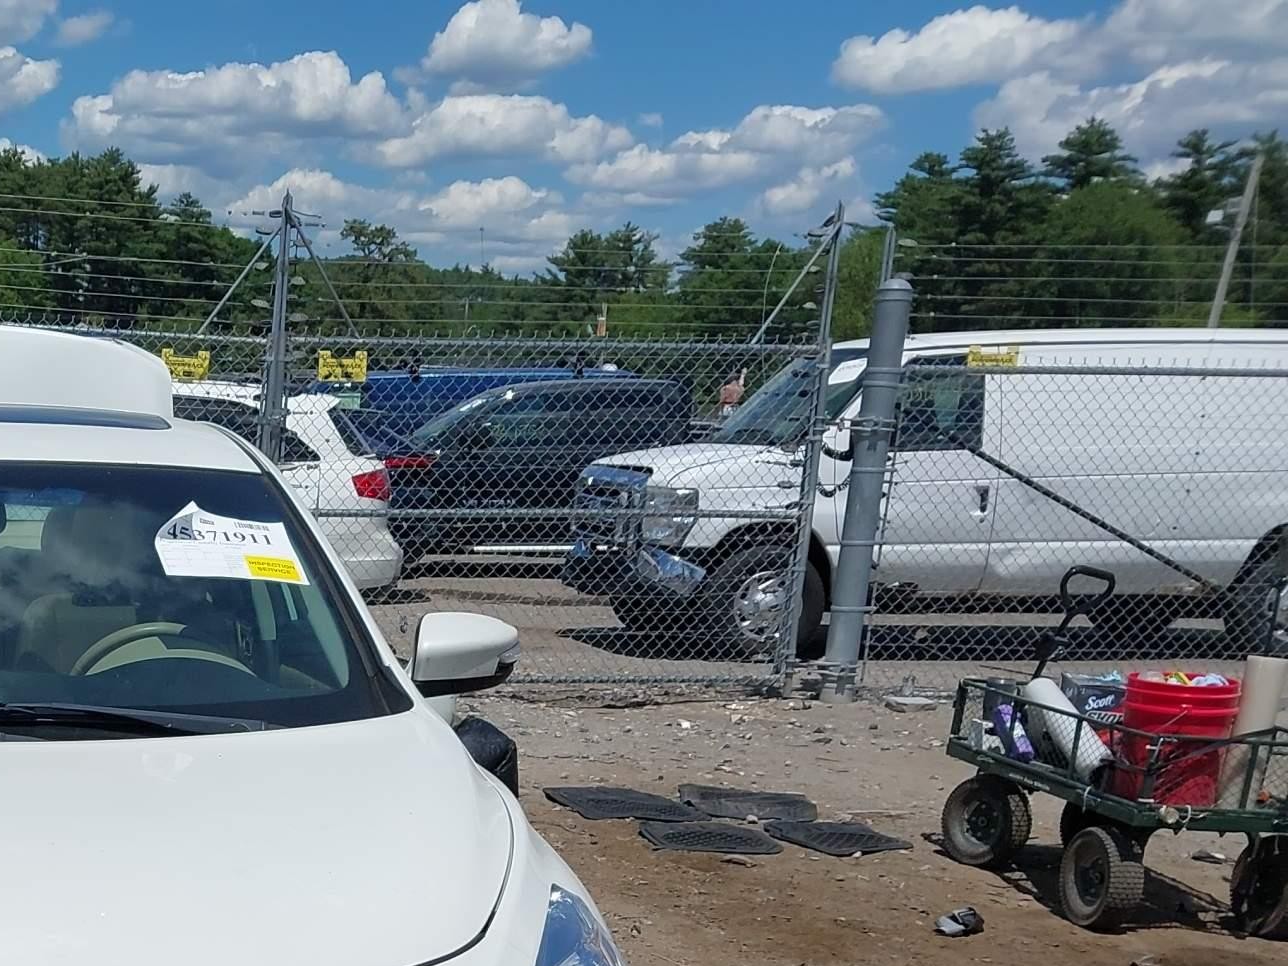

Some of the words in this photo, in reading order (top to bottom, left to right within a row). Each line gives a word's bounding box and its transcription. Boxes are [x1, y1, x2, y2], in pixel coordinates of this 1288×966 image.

[167, 523, 272, 545] 45371911
[248, 560, 296, 570] INSPECTION
[256, 566, 291, 575] SERVICE
[1085, 694, 1115, 710] Scott
